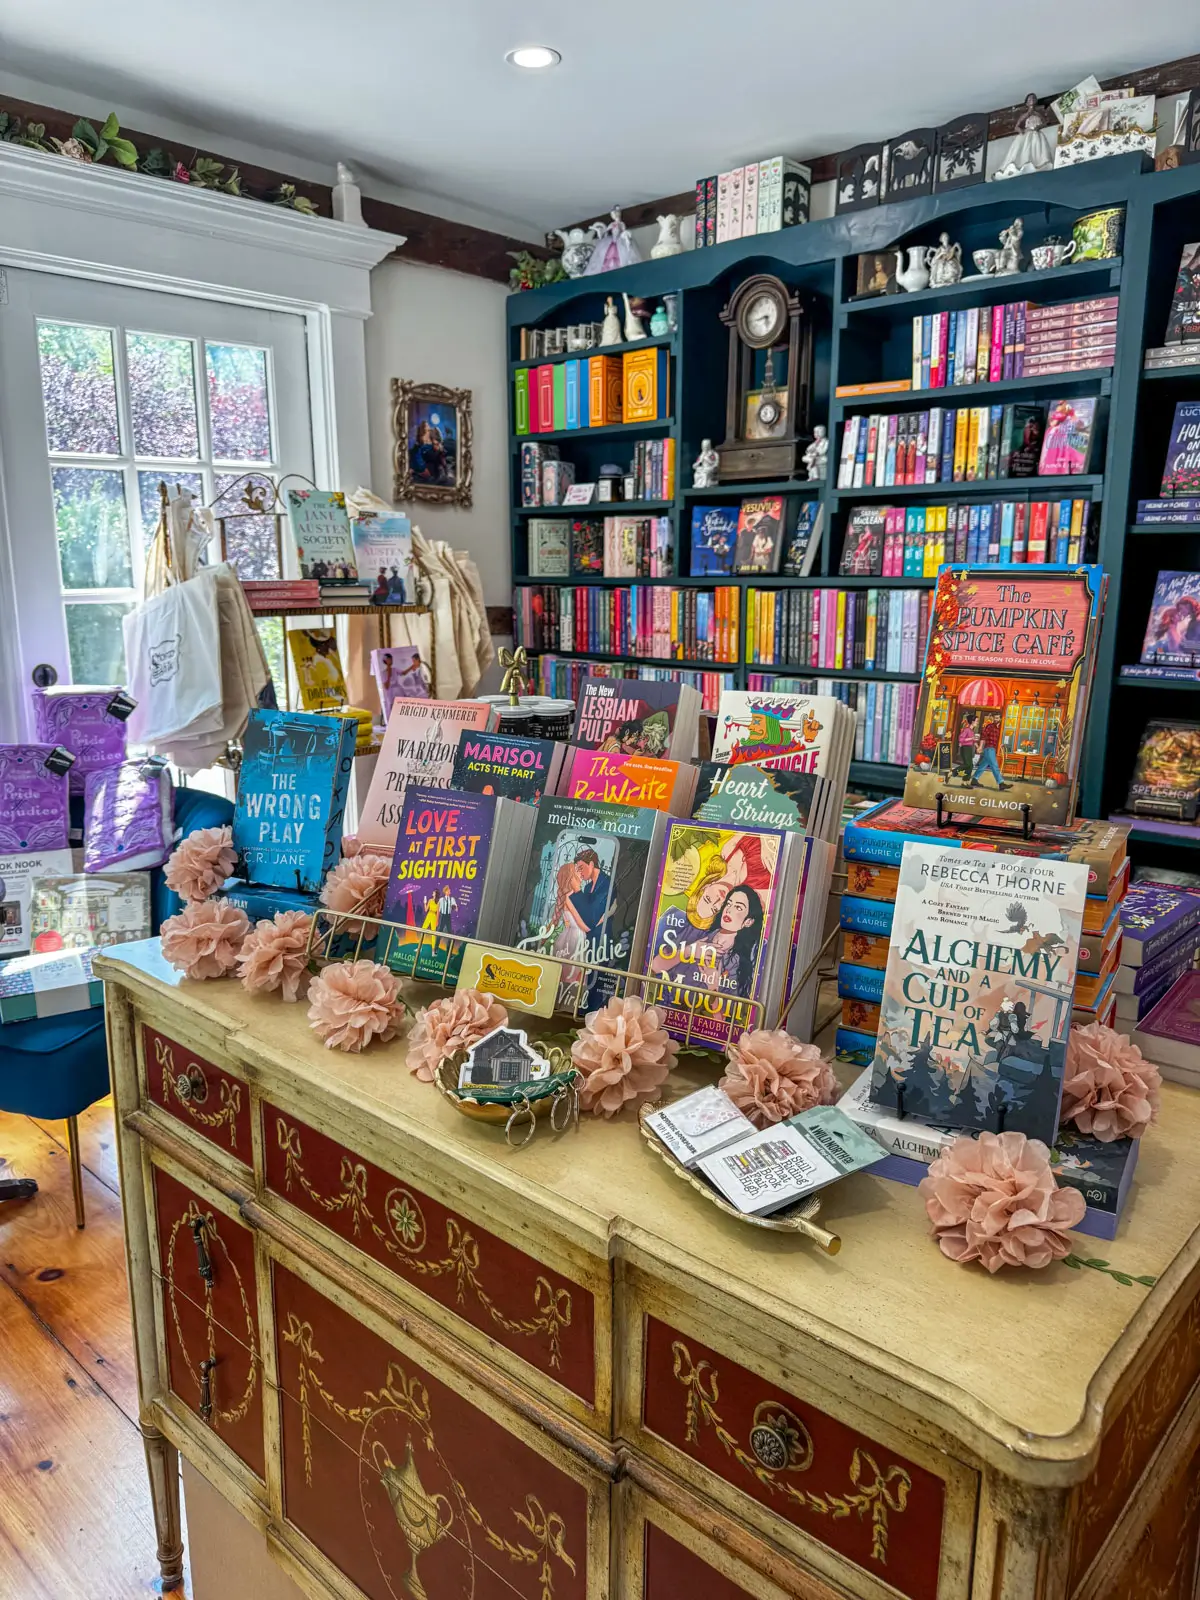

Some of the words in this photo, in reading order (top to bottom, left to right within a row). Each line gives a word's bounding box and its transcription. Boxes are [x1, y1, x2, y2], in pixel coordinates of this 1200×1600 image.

[305, 510, 336, 521] JANE
[298, 523, 348, 534] AUSTEN
[303, 536, 347, 544] SOCIETY
[997, 585, 1031, 604] The
[956, 606, 1068, 630] PUMPKIN
[942, 630, 1005, 653] SPICE
[1012, 629, 1075, 657] CAFÉ
[586, 684, 597, 696] The
[598, 685, 615, 697] New
[399, 705, 429, 718] BRIGID
[430, 707, 478, 722] KEMMERER
[581, 696, 639, 721] LESBIAN
[70, 729, 105, 746] Pride
[577, 719, 613, 743] PULP
[397, 738, 459, 763] WARRIOR
[463, 741, 545, 770] MARISOL
[467, 761, 491, 774] ACTS
[492, 764, 510, 777] THE
[511, 767, 535, 780] PART
[589, 757, 621, 778] The
[3, 782, 41, 800] Pride
[272, 773, 296, 790] THE
[573, 776, 668, 803] Re-Write
[710, 768, 769, 799] Heart
[940, 793, 976, 805] AURIE
[1131, 784, 1195, 800] SPELLSHOP
[246, 793, 321, 820] WRONG
[730, 798, 797, 829] Strings
[405, 809, 461, 835] LOVE
[547, 812, 596, 829] melissa
[603, 820, 641, 835] marr
[258, 822, 305, 844] PLAY
[408, 841, 423, 854] AT
[423, 835, 481, 858] FIRST
[860, 847, 892, 857] LAURIE
[14, 860, 42, 869] NOOK
[244, 852, 267, 864] C.R.
[272, 854, 305, 866] JANE
[938, 855, 962, 864] Tomes
[973, 860, 986, 868] Tea
[1000, 863, 1028, 873] BOOK
[1030, 867, 1055, 877] FOUR
[397, 859, 478, 880] SIGHTING
[920, 863, 990, 885] REBECCA
[995, 874, 1067, 896] THORNE
[955, 884, 974, 892] TODAY
[974, 886, 1013, 898] BESTSELLING
[1014, 892, 1040, 902] AUTHOR
[232, 900, 249, 909] PLAY
[666, 914, 685, 929] the
[856, 916, 888, 928] LAURIE
[517, 924, 555, 956] Tni
[556, 942, 570, 958] and
[570, 932, 627, 968] Addie
[658, 929, 717, 969] Sun
[900, 928, 1064, 983] ALCHEMY
[393, 951, 417, 962] MALLOR
[420, 958, 445, 969] MARLOW
[492, 963, 537, 983] MONTGOMERY
[692, 972, 716, 986] and
[718, 974, 738, 990] the
[935, 966, 970, 985] AND
[979, 976, 992, 989] A
[500, 981, 507, 990] &
[507, 980, 534, 995] TAGGERT
[558, 981, 590, 1010] Virl
[656, 970, 743, 1021] Moon
[853, 984, 885, 996] LAURIE
[902, 972, 970, 1012] CUP
[963, 1005, 987, 1021] OF
[665, 1009, 695, 1025] EKA
[700, 1027, 719, 1037] Lovers
[904, 1005, 982, 1056] TEA
[814, 1127, 831, 1147] WILD
[826, 1139, 849, 1162] NORTH
[892, 1137, 942, 1159] ALCHEMY
[781, 1160, 810, 1186] Riding
[791, 1154, 812, 1172] Still
[750, 1172, 769, 1190] Fair
[760, 1168, 782, 1189] Book
[771, 1164, 792, 1184] That
[740, 1177, 760, 1197] High
